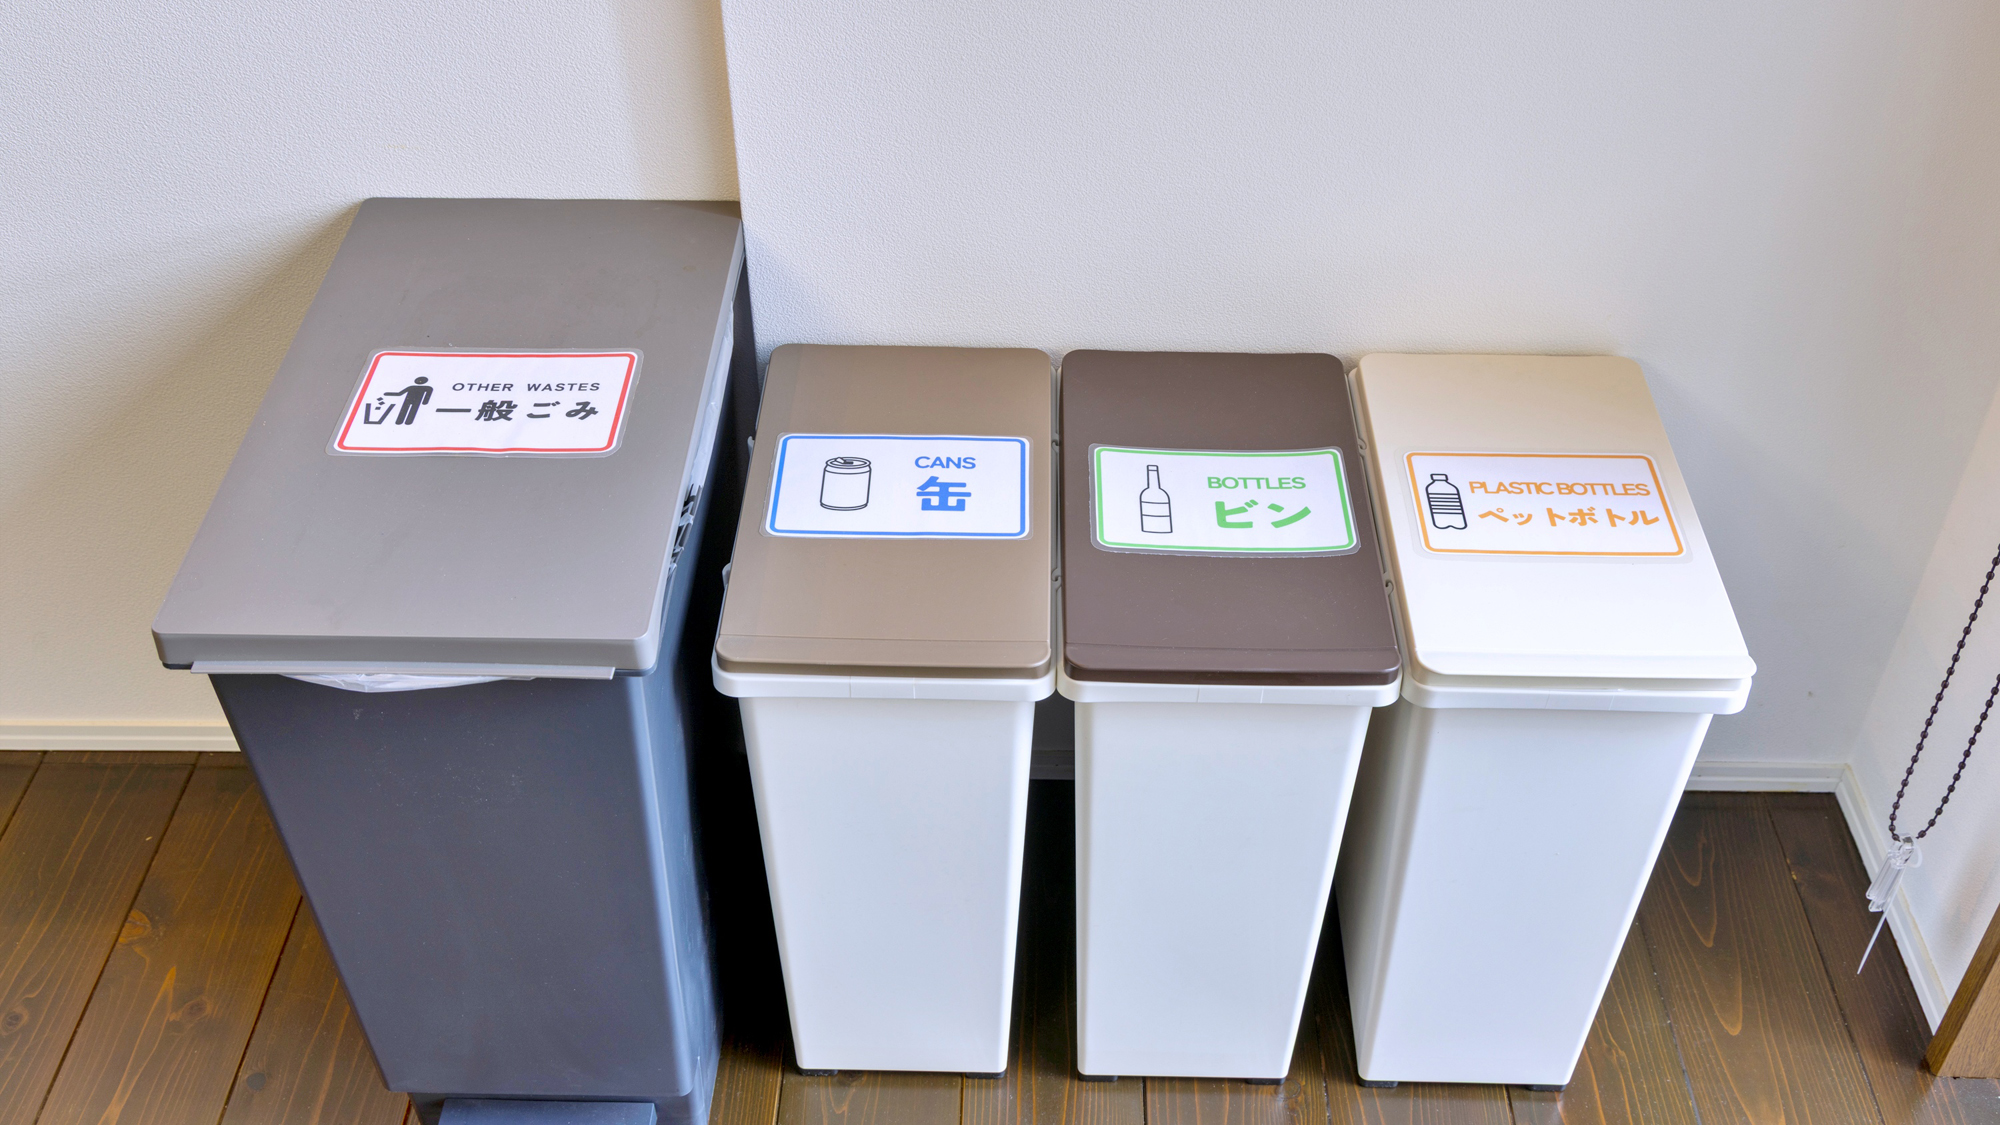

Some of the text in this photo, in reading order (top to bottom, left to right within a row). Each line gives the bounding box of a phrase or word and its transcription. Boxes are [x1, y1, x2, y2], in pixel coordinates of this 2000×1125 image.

[452, 382, 600, 392] OTHER WASTES
[435, 400, 599, 422] 一般ごみ
[914, 455, 977, 470] CANS
[1207, 476, 1307, 490] BOTTLES
[1468, 480, 1651, 497] PLASTIC BOTTLES
[916, 475, 972, 512] 缶
[1214, 499, 1312, 529] ビン
[1477, 504, 1661, 527] ペットボトル
